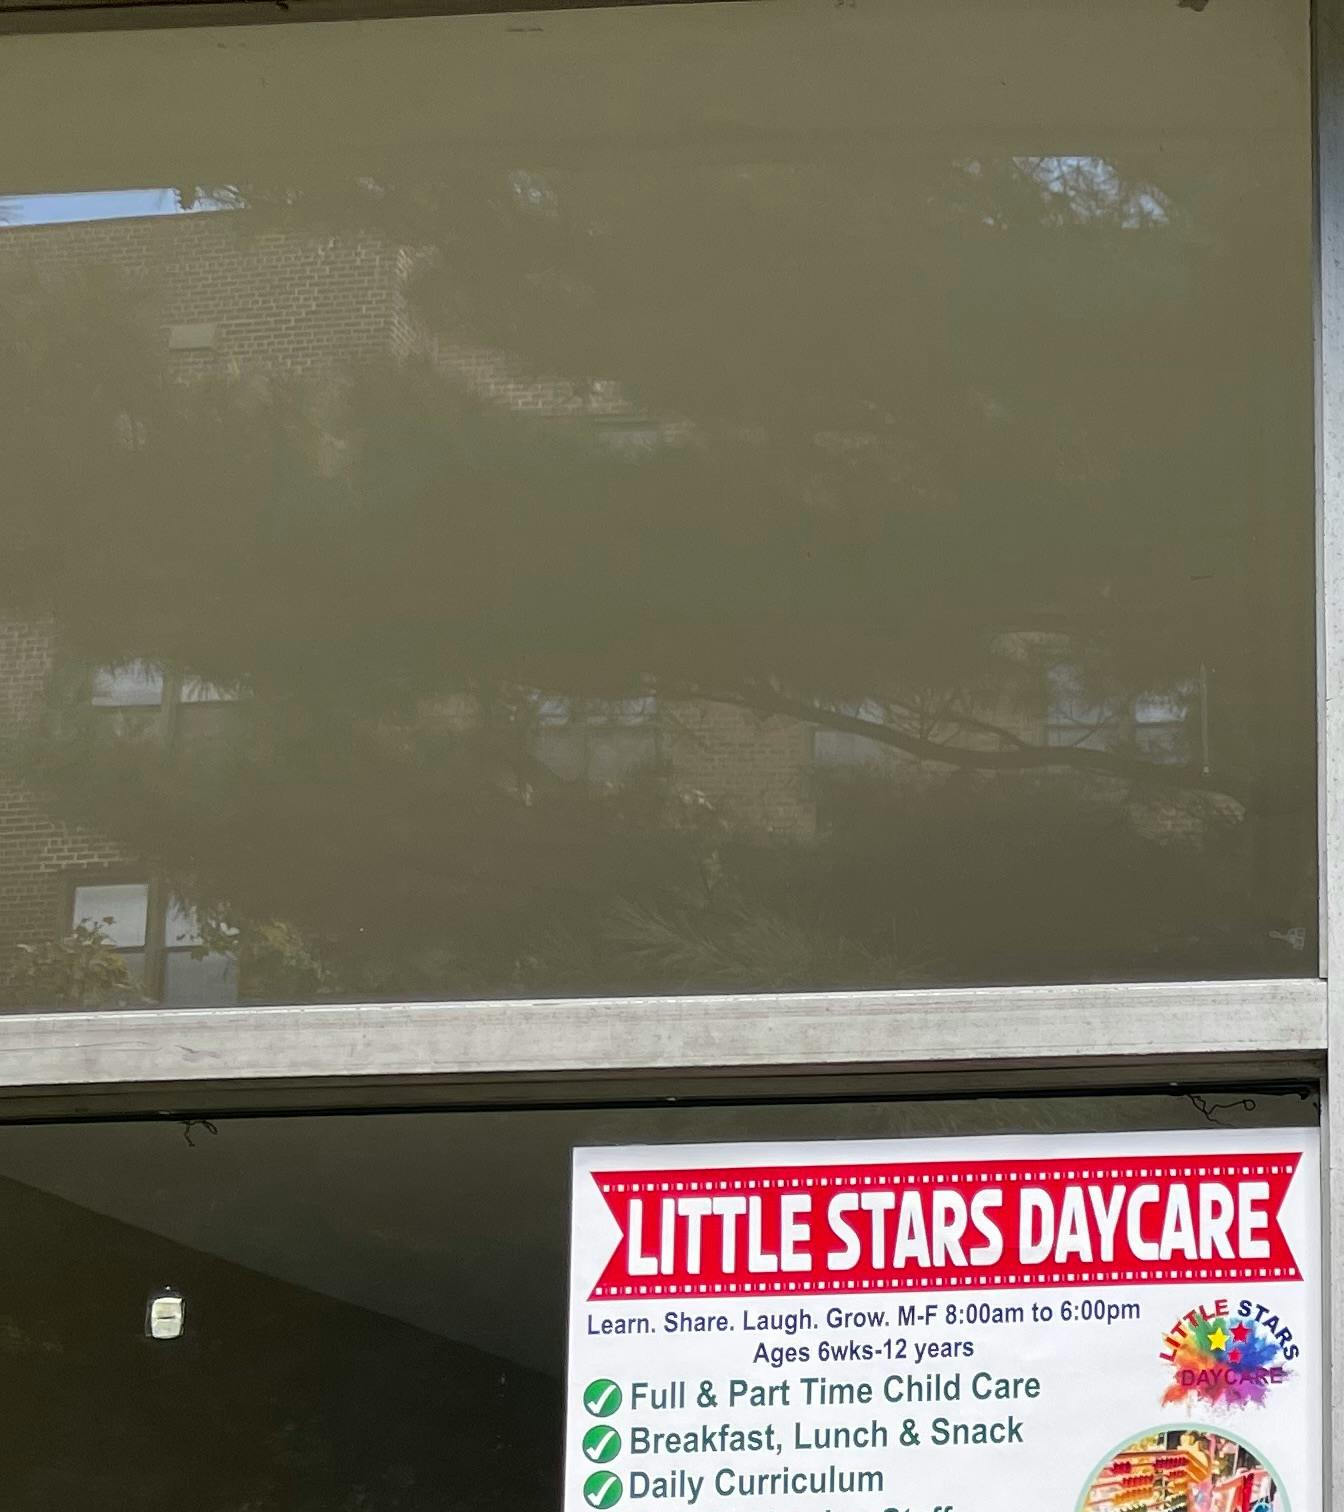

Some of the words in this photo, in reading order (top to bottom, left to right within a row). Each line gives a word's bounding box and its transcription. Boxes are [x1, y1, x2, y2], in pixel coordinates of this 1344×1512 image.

[628, 1194, 812, 1276] LITTLE
[828, 1189, 1003, 1270] STARS
[1019, 1181, 1270, 1264] DAYCARE
[588, 1315, 655, 1335] Learn.
[664, 1312, 734, 1332] Share.
[744, 1309, 816, 1335] Laugh.
[827, 1308, 889, 1328] Grow.
[899, 1305, 938, 1326] M-F
[946, 1303, 1023, 1324] 8:00am
[1032, 1303, 1052, 1322] to
[1061, 1300, 1140, 1325] 6:00pm
[1159, 1299, 1230, 1362] LITTLE
[1237, 1300, 1300, 1361] STARS
[753, 1343, 809, 1368] Ages
[819, 1338, 906, 1361] 6wks-12
[914, 1342, 974, 1364] years
[632, 1381, 685, 1410] Full
[697, 1380, 718, 1408] &
[730, 1380, 790, 1407] Part
[804, 1378, 872, 1405] Time
[884, 1373, 960, 1402] Child
[972, 1372, 1040, 1400] Care
[1181, 1367, 1284, 1386] DAYCARE
[631, 1424, 783, 1456] Breakfast,
[795, 1420, 887, 1449] Lunch
[900, 1419, 920, 1446] &
[931, 1416, 1023, 1445] Snack
[630, 1470, 704, 1504] Daily
[715, 1465, 883, 1496] Curriculum
